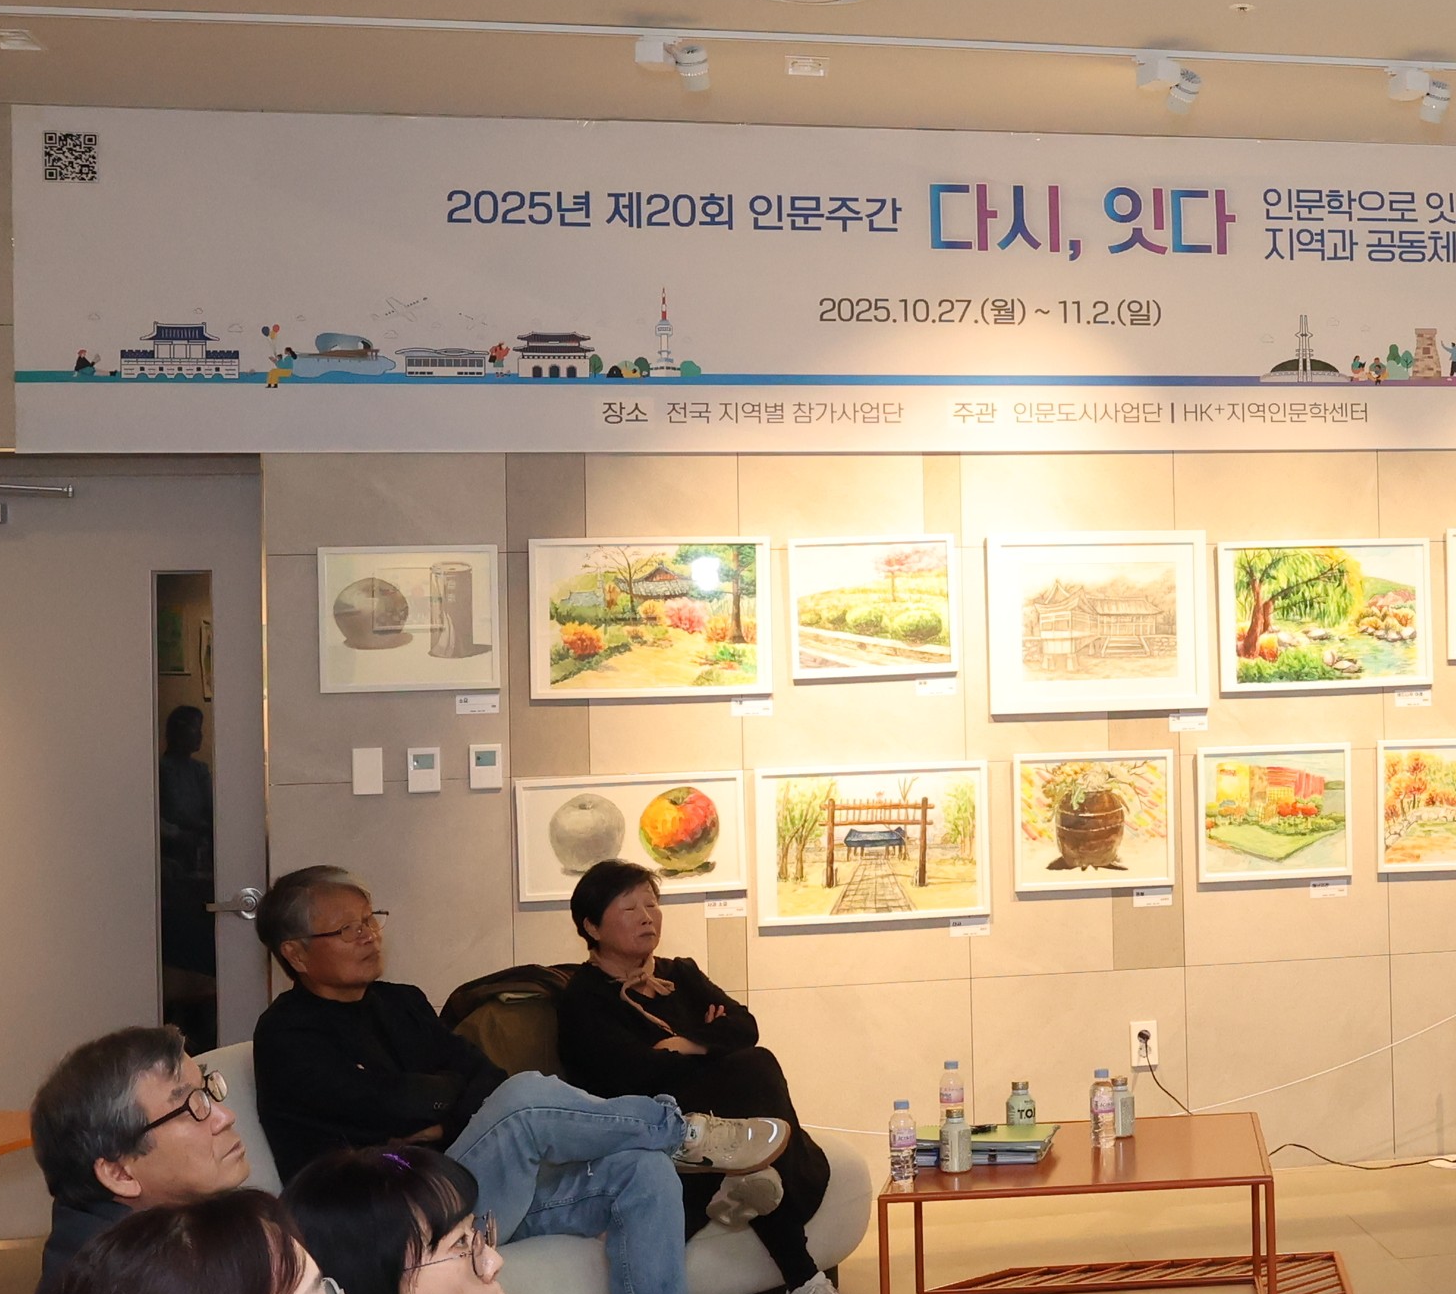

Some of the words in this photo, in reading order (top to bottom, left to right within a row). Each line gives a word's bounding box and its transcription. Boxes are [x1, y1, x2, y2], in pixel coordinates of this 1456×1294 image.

[446, 188, 592, 229] 2025년
[606, 191, 736, 231] 제20회
[749, 194, 903, 234] 인문주간
[928, 182, 1082, 261] 다시,
[1105, 186, 1237, 256] 잇다
[1262, 187, 1417, 227] 인문학으로
[1264, 227, 1358, 263] 지역과
[819, 296, 1026, 328] 2025.10.27.(월)
[1057, 298, 1163, 328] 11.2.(일)
[602, 401, 648, 424] 장소
[666, 401, 711, 425] 전국
[718, 401, 786, 425] 지역별
[793, 401, 905, 425] 참가사업단
[953, 401, 997, 424] 주관
[1013, 401, 1164, 424] 인문도시사업단
